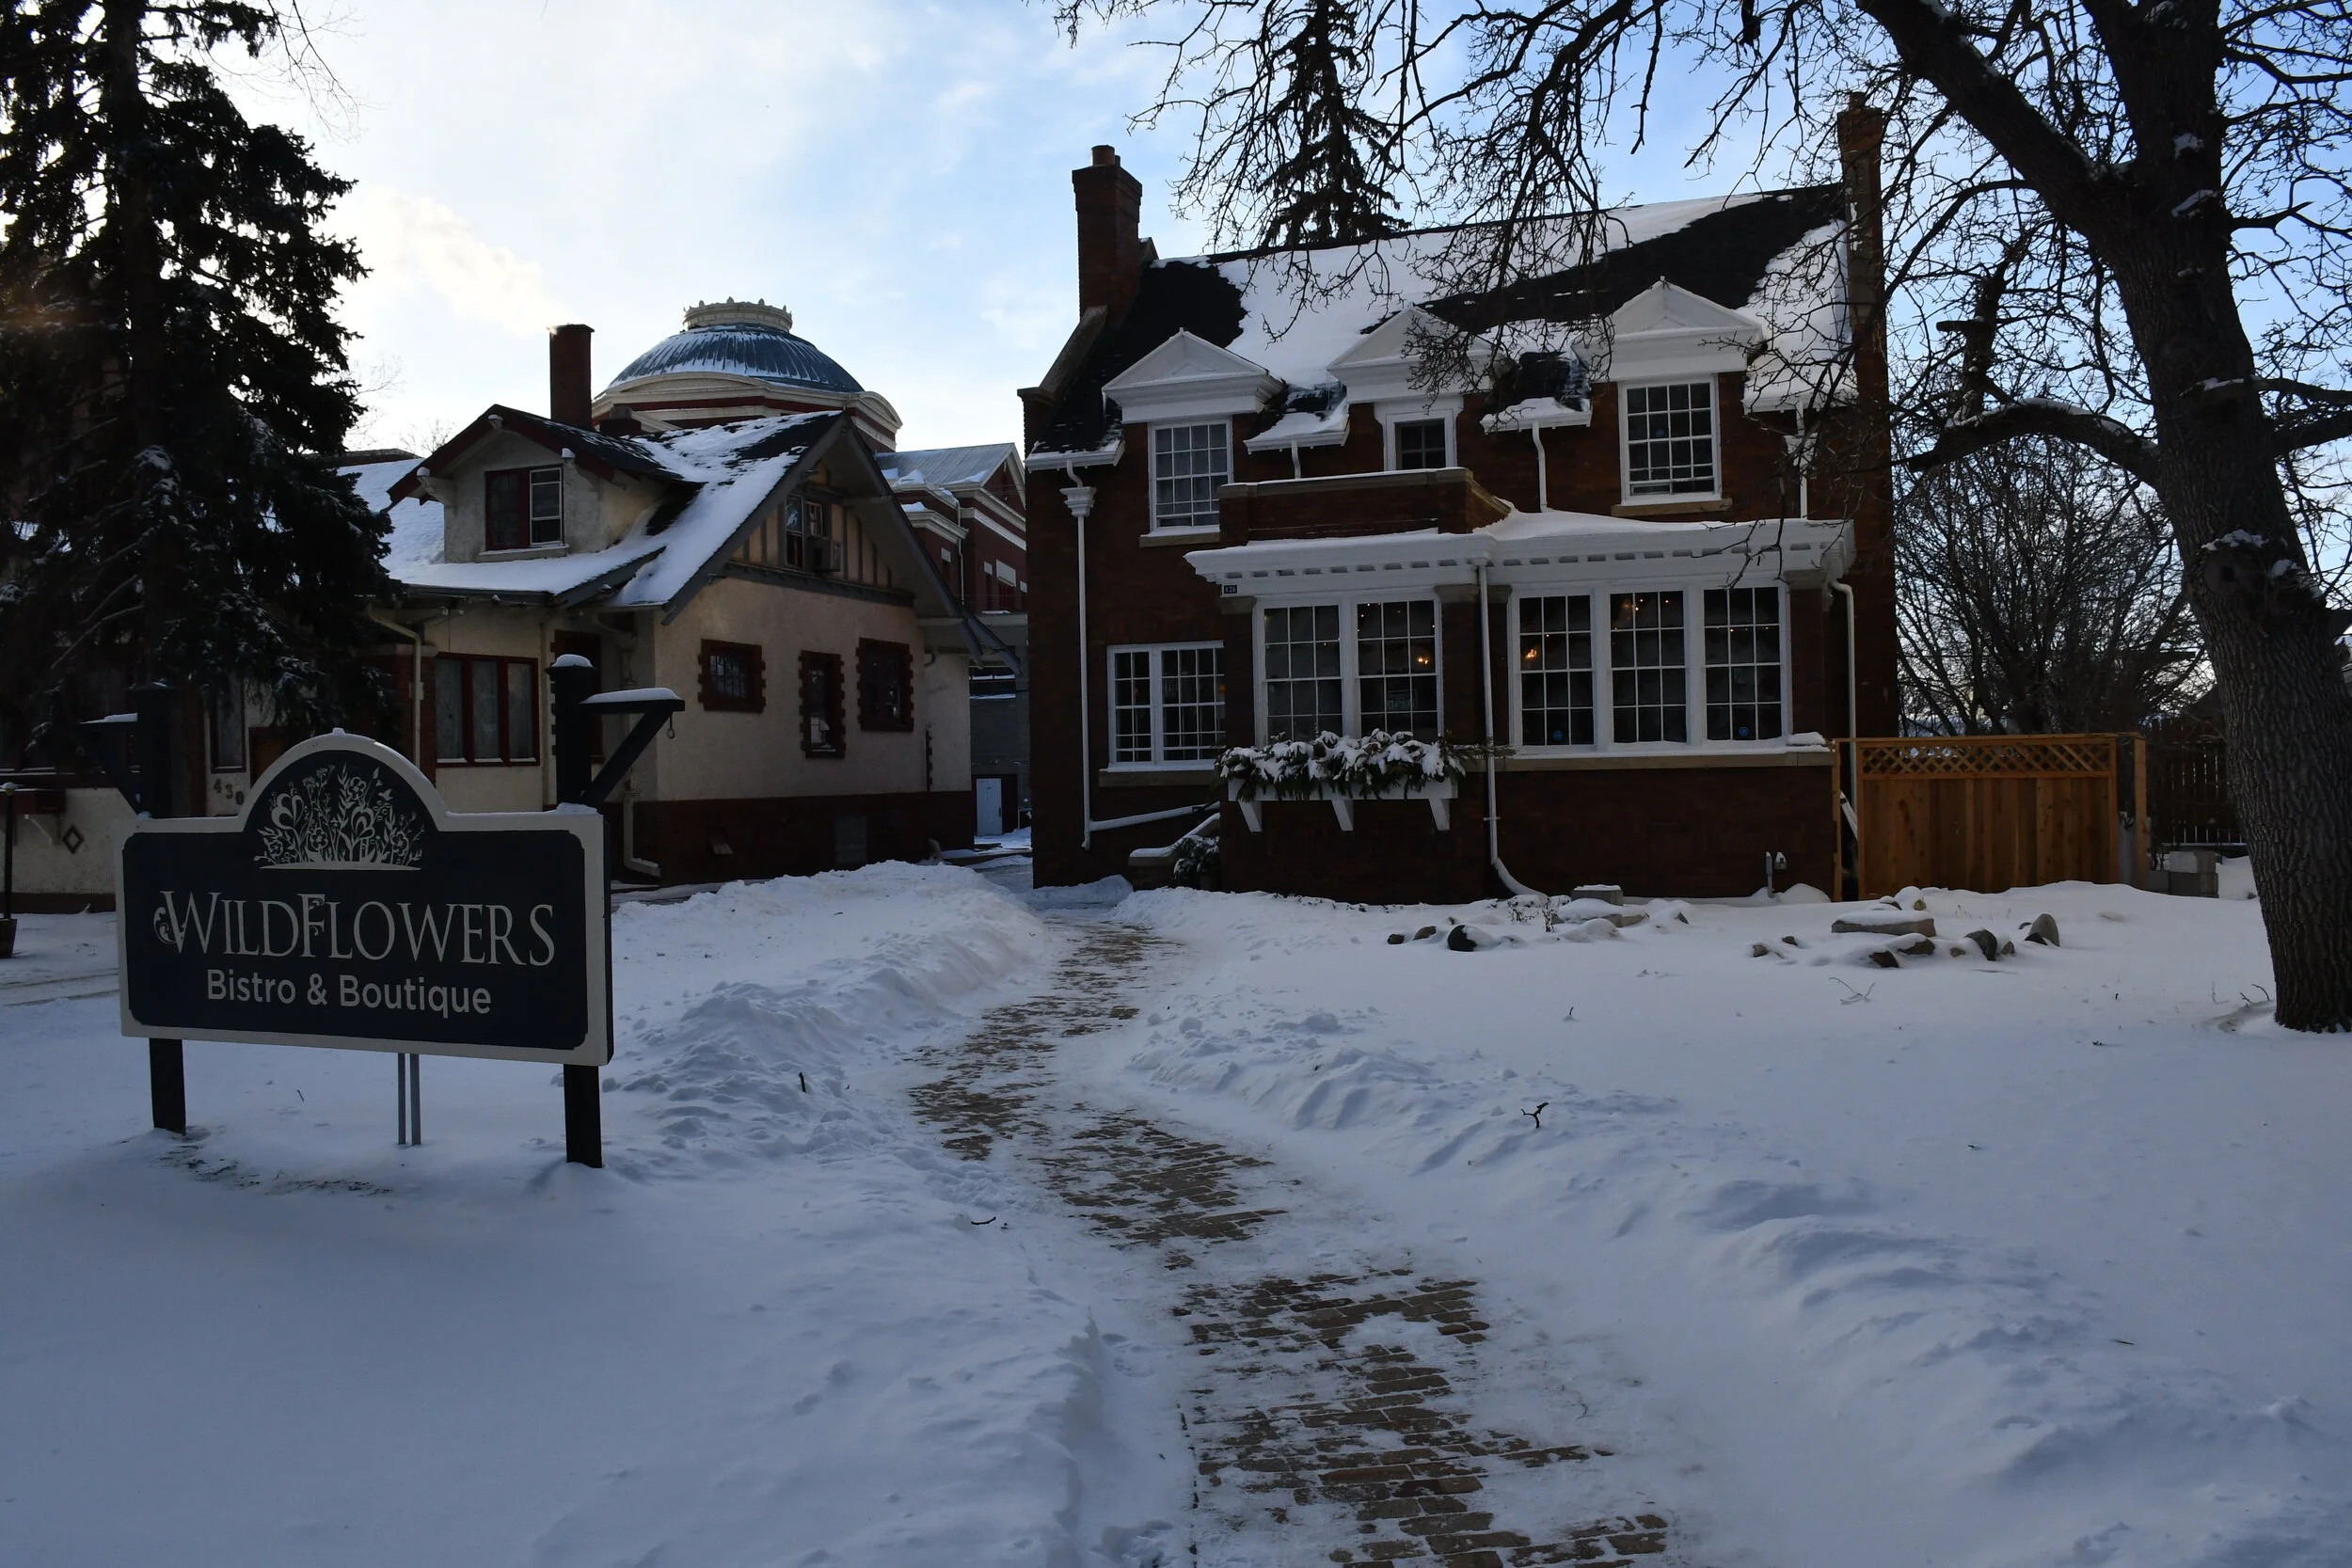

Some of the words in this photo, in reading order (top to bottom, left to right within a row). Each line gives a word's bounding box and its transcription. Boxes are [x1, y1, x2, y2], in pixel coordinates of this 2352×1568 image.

[214, 779, 245, 805] 430
[153, 890, 555, 967] WILDFLOWERS
[207, 969, 296, 1005] Bistro
[307, 974, 328, 1006] &
[340, 975, 492, 1019] Boutique
